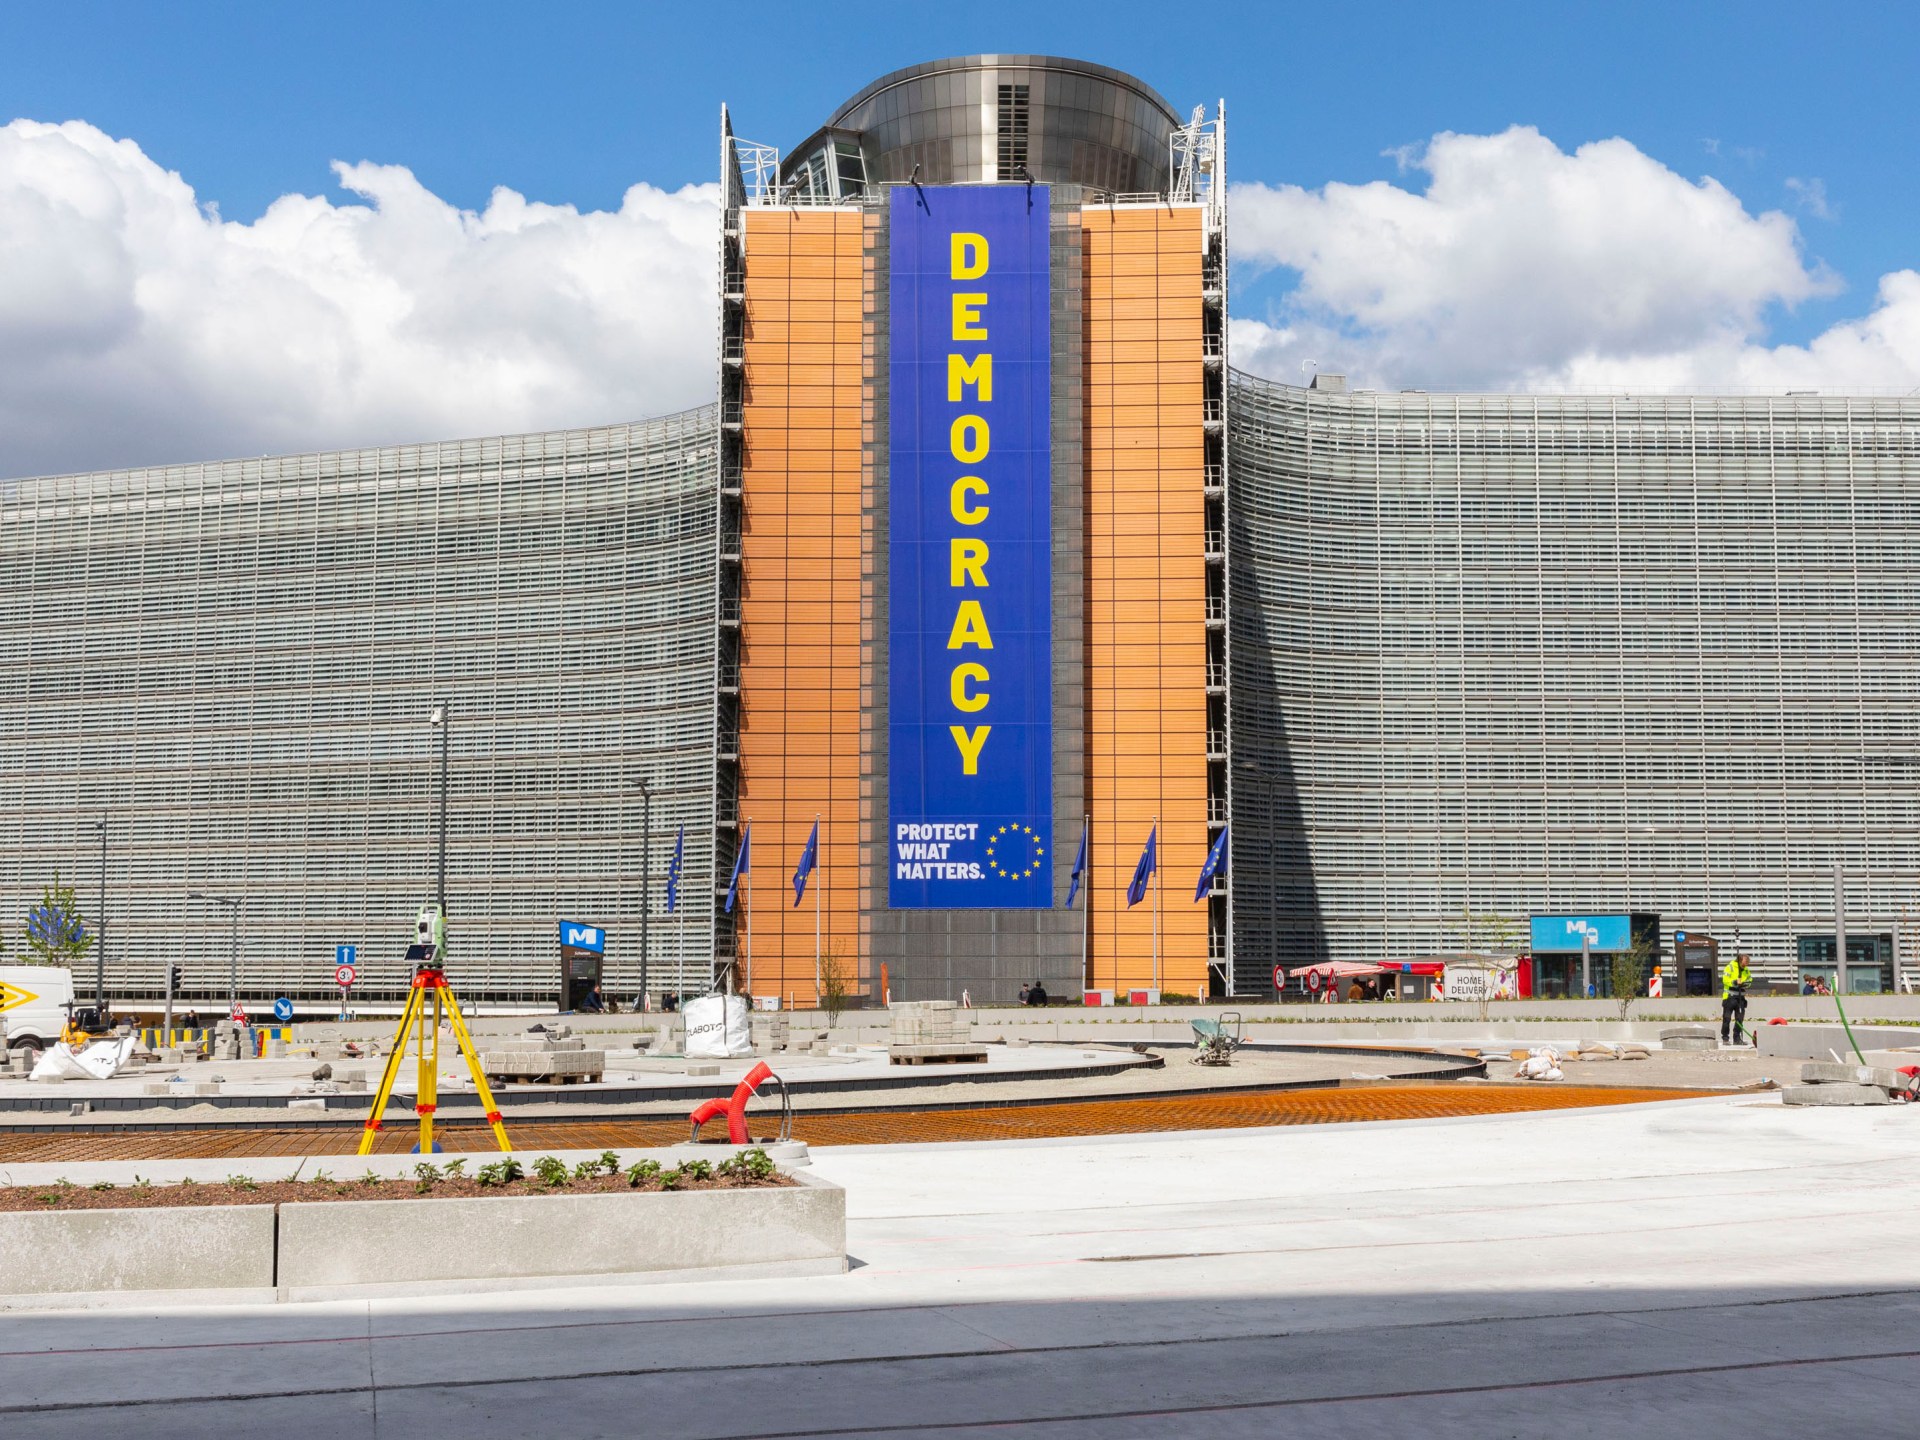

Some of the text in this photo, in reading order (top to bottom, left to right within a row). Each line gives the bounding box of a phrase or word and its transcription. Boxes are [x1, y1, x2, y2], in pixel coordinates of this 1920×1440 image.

[948, 233, 993, 774] DEMOCRACY
[897, 824, 978, 840] PROTECT
[897, 844, 950, 860] WHAT
[897, 863, 985, 879] MATTERS.
[1566, 920, 1587, 934] M
[568, 928, 597, 945] M
[1457, 976, 1482, 985] HOME
[1451, 985, 1488, 994] DELIVERY
